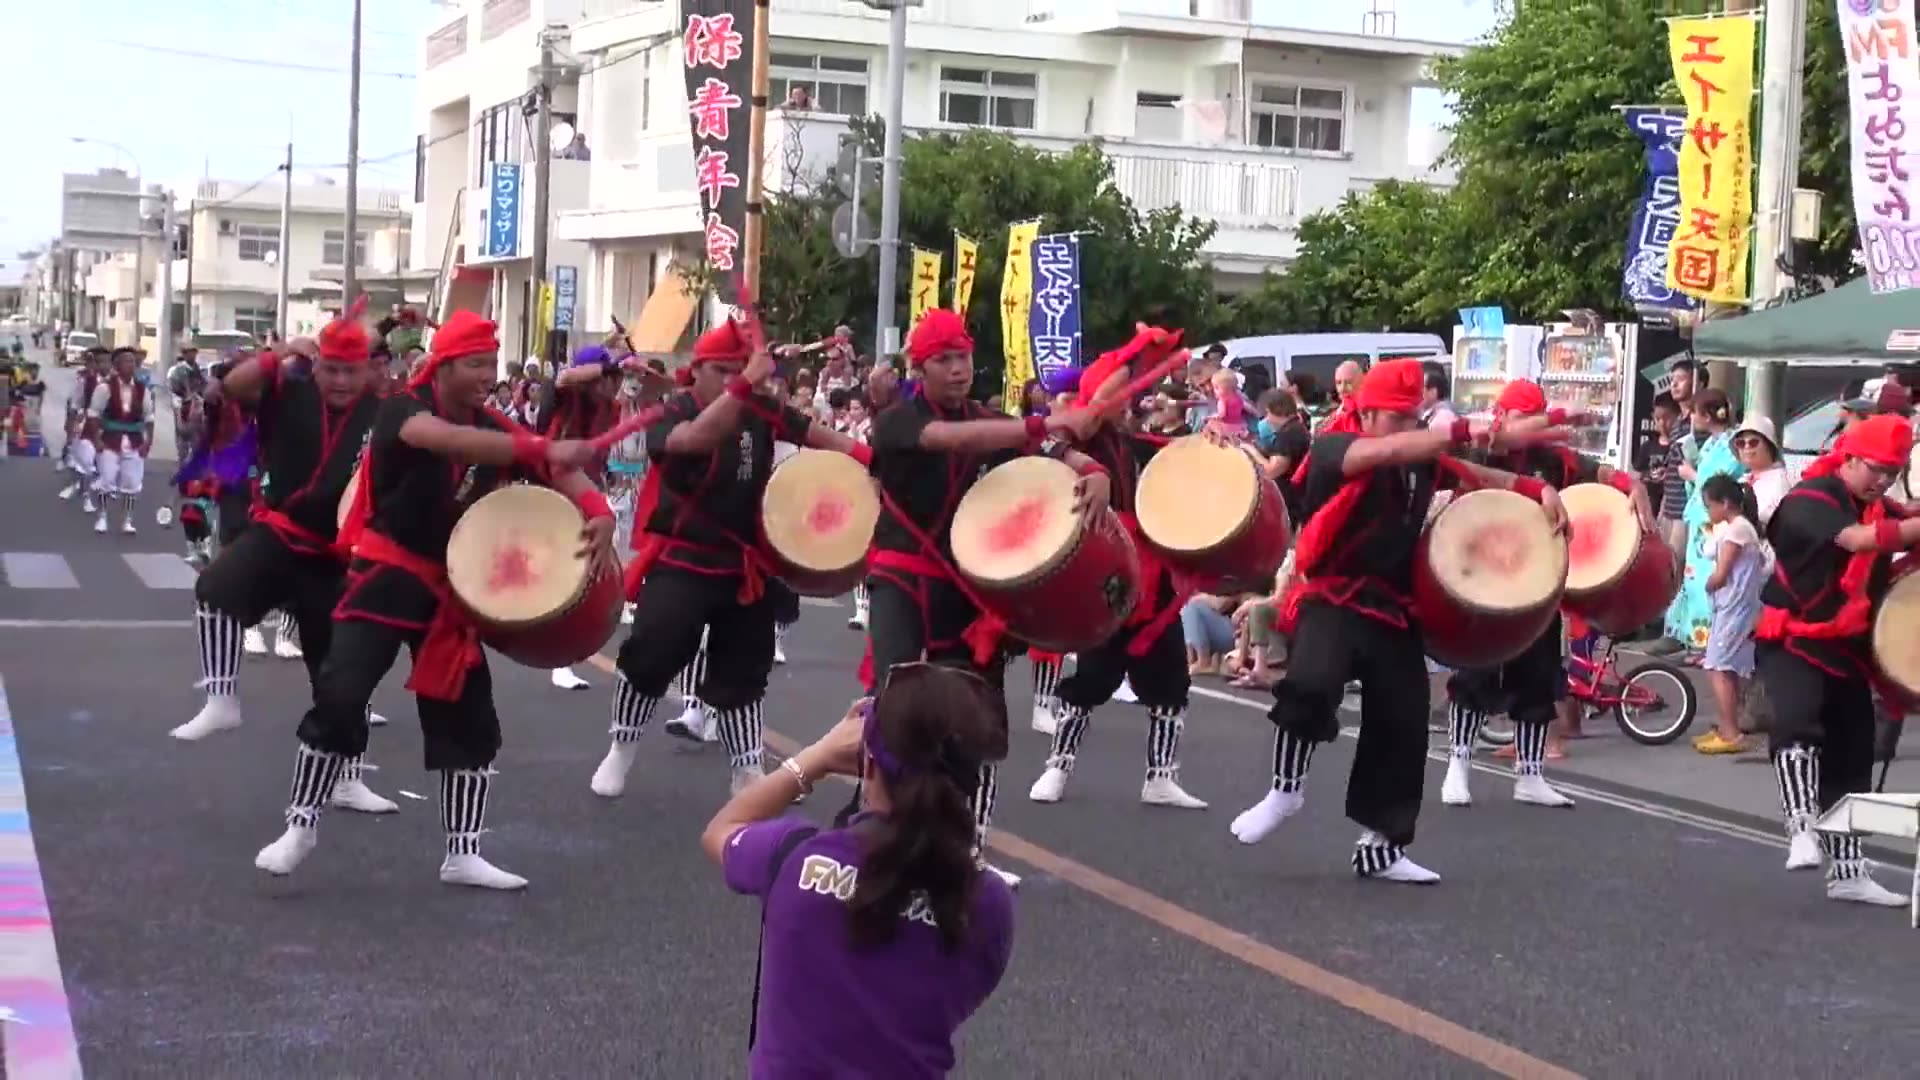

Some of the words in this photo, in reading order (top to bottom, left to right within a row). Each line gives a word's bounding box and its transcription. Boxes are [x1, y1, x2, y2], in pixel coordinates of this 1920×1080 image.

[685, 13, 743, 270] 保青年会
[798, 854, 858, 900] FM
